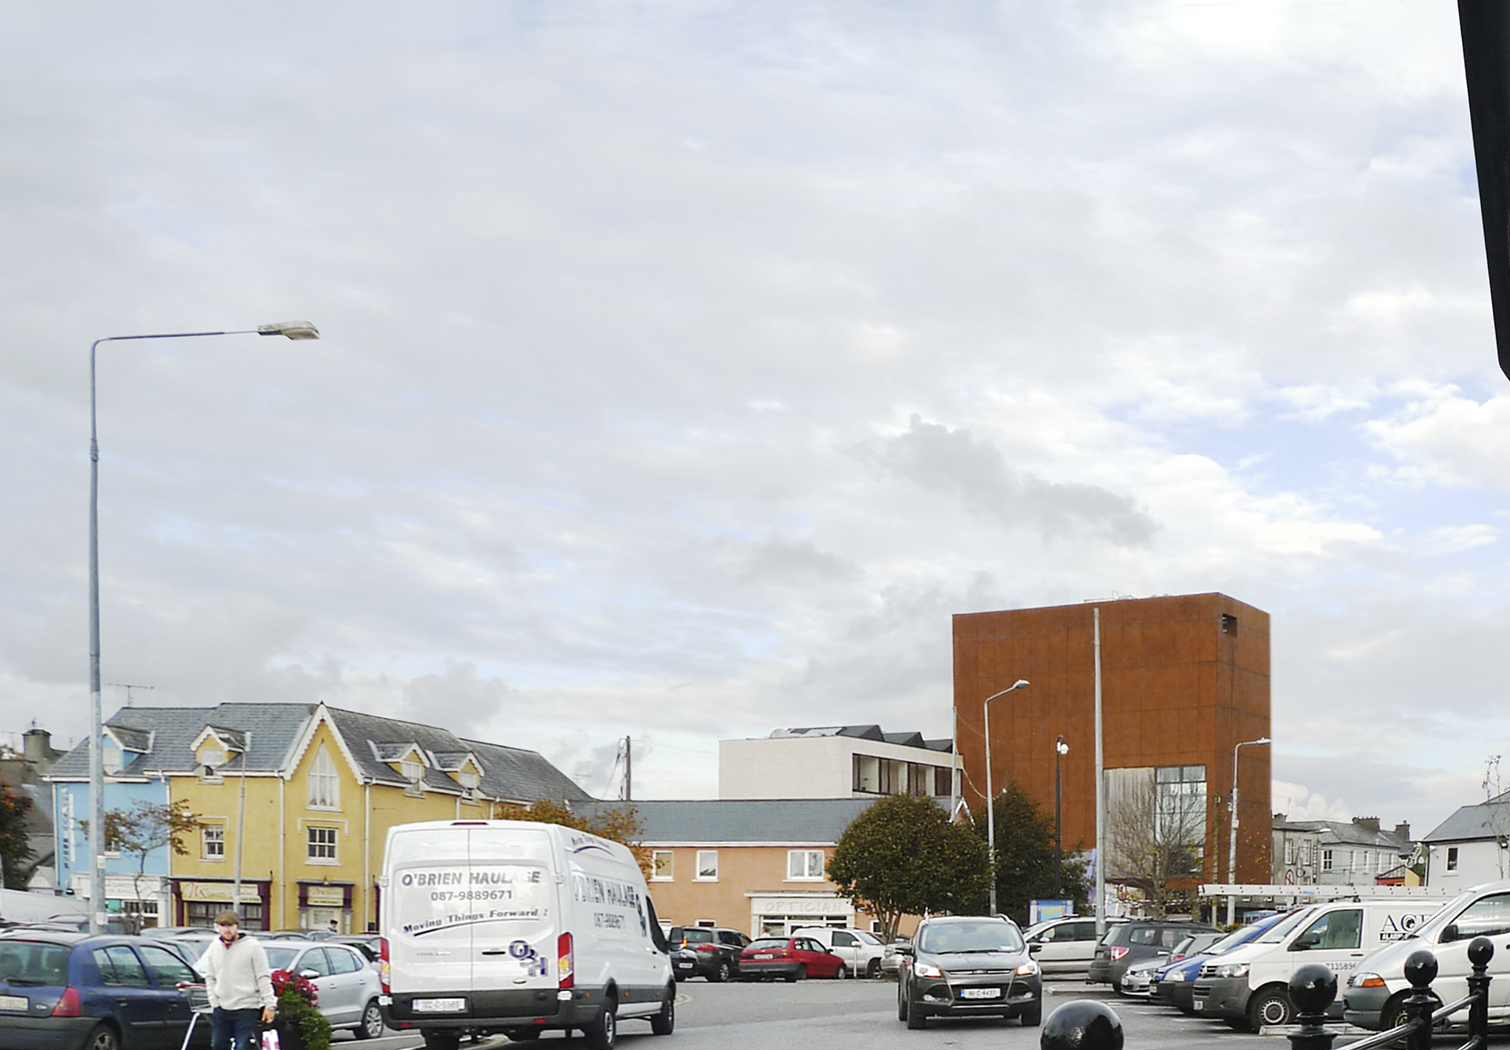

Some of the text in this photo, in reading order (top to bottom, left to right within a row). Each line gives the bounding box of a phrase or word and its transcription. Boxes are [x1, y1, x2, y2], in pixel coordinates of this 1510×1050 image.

[402, 873, 462, 886] O'BRIEN
[431, 890, 512, 901] 087-9889671
[765, 901, 840, 912] OPTICIAN
[403, 919, 442, 933] Moving
[447, 913, 484, 923] Things
[489, 909, 538, 918] Forward
